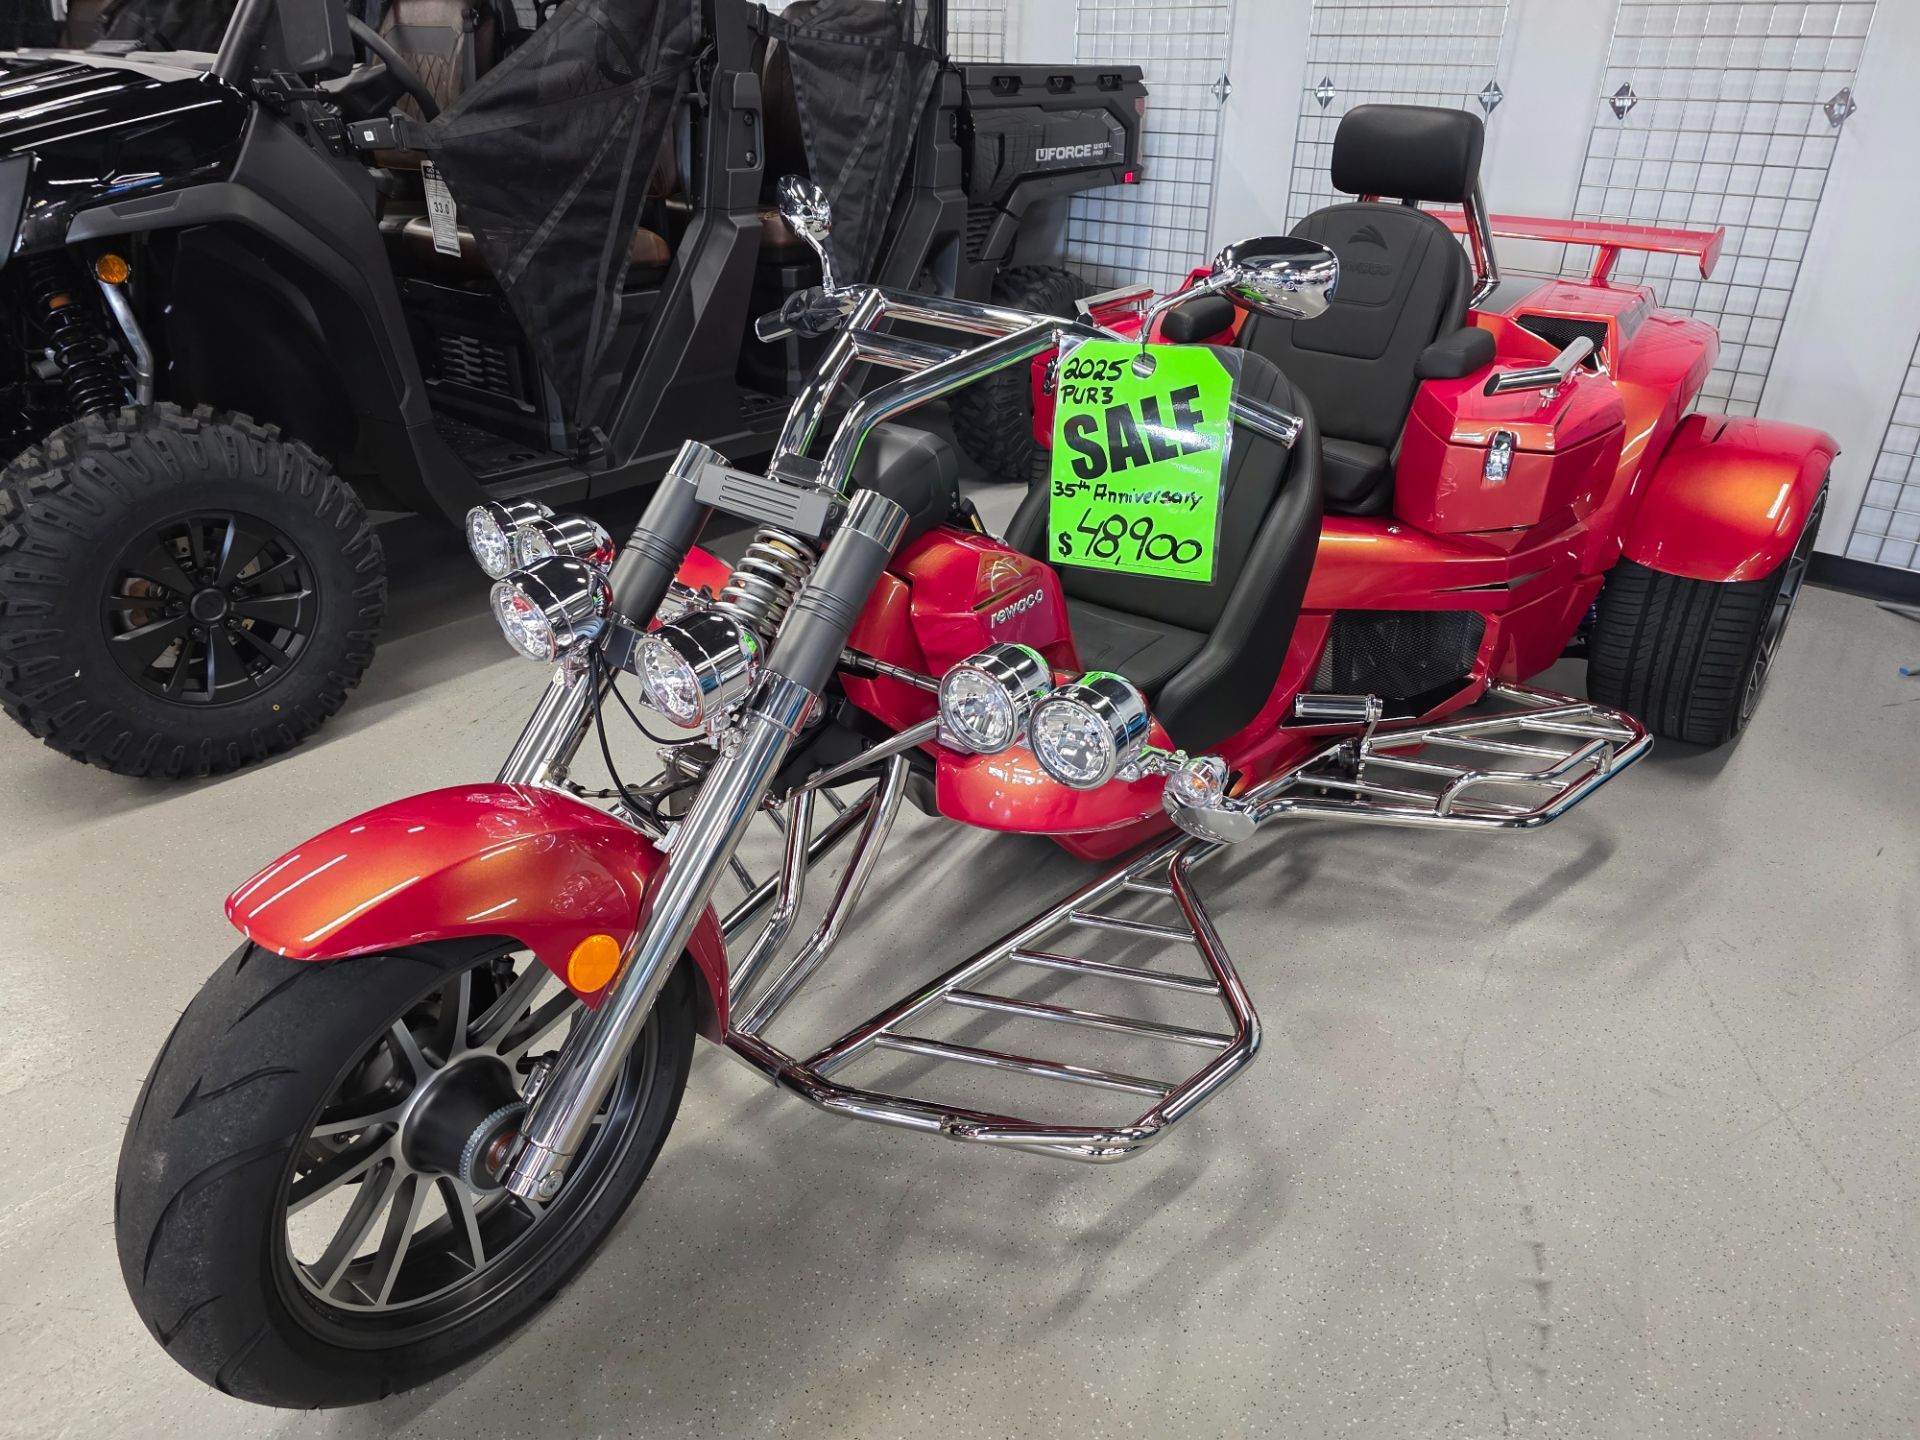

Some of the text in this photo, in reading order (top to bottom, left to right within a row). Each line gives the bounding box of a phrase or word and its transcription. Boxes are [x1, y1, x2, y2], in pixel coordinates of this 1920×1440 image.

[1036, 144, 1092, 162] UFORCE
[1063, 357, 1130, 381] 2025
[1063, 384, 1212, 480] SALE
[1052, 480, 1203, 511] 35th Anniversary
[991, 588, 1044, 629] rewaco
